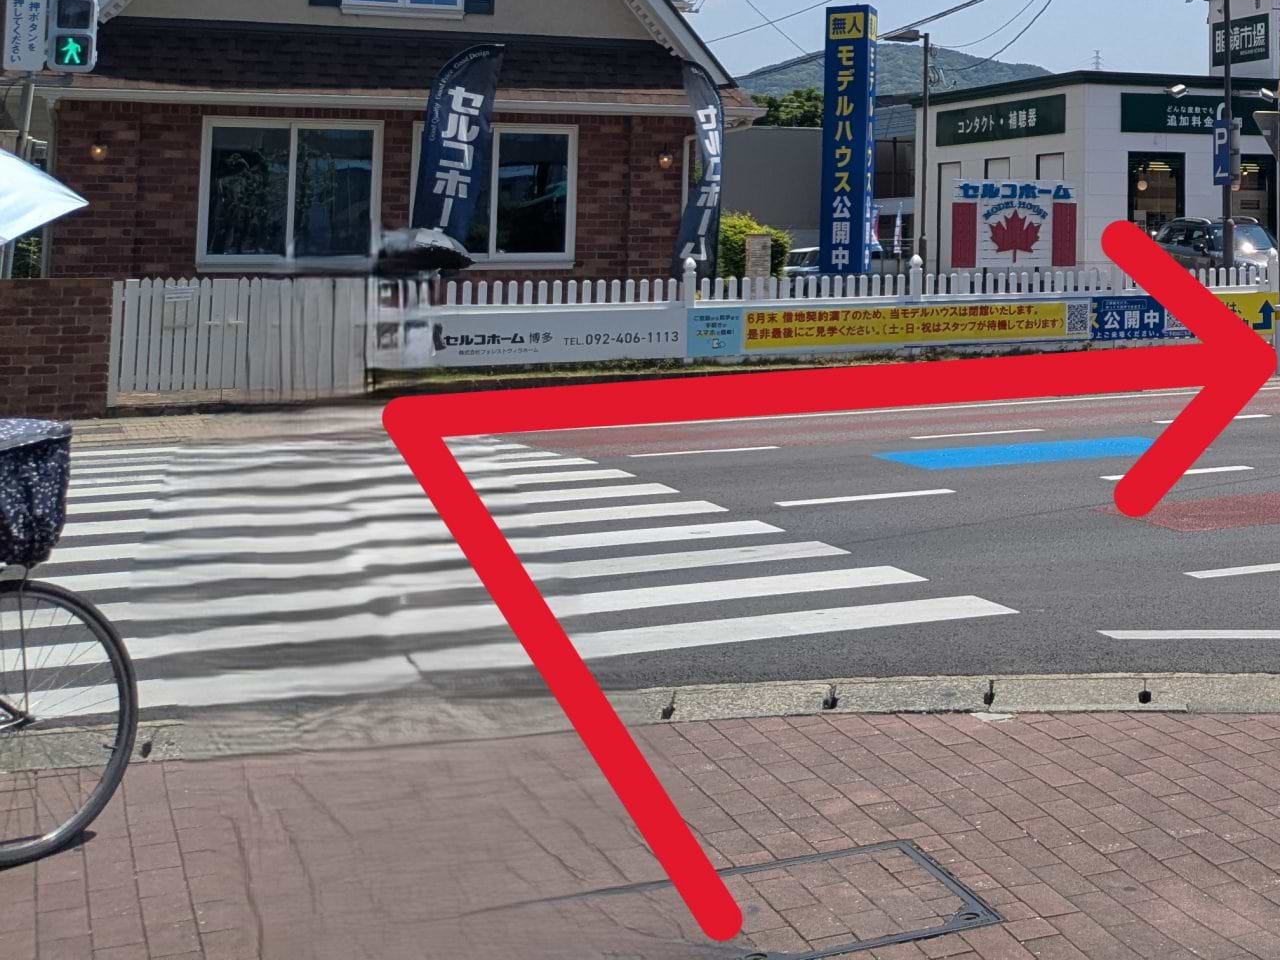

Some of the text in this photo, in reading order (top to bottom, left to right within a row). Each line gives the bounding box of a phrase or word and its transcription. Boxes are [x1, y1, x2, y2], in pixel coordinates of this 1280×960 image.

[28, 1, 41, 51] 押ボタンを
[831, 16, 862, 35] 無人
[1215, 127, 1228, 155] P
[432, 86, 484, 231] セルコホー
[831, 45, 855, 271] モデルハウス公開中
[959, 183, 1072, 200] セルコホーム
[982, 200, 1049, 220] MODEL HOUSE
[747, 311, 778, 324] 6月末
[443, 333, 525, 346] セルコホーム
[529, 331, 553, 344] 博多
